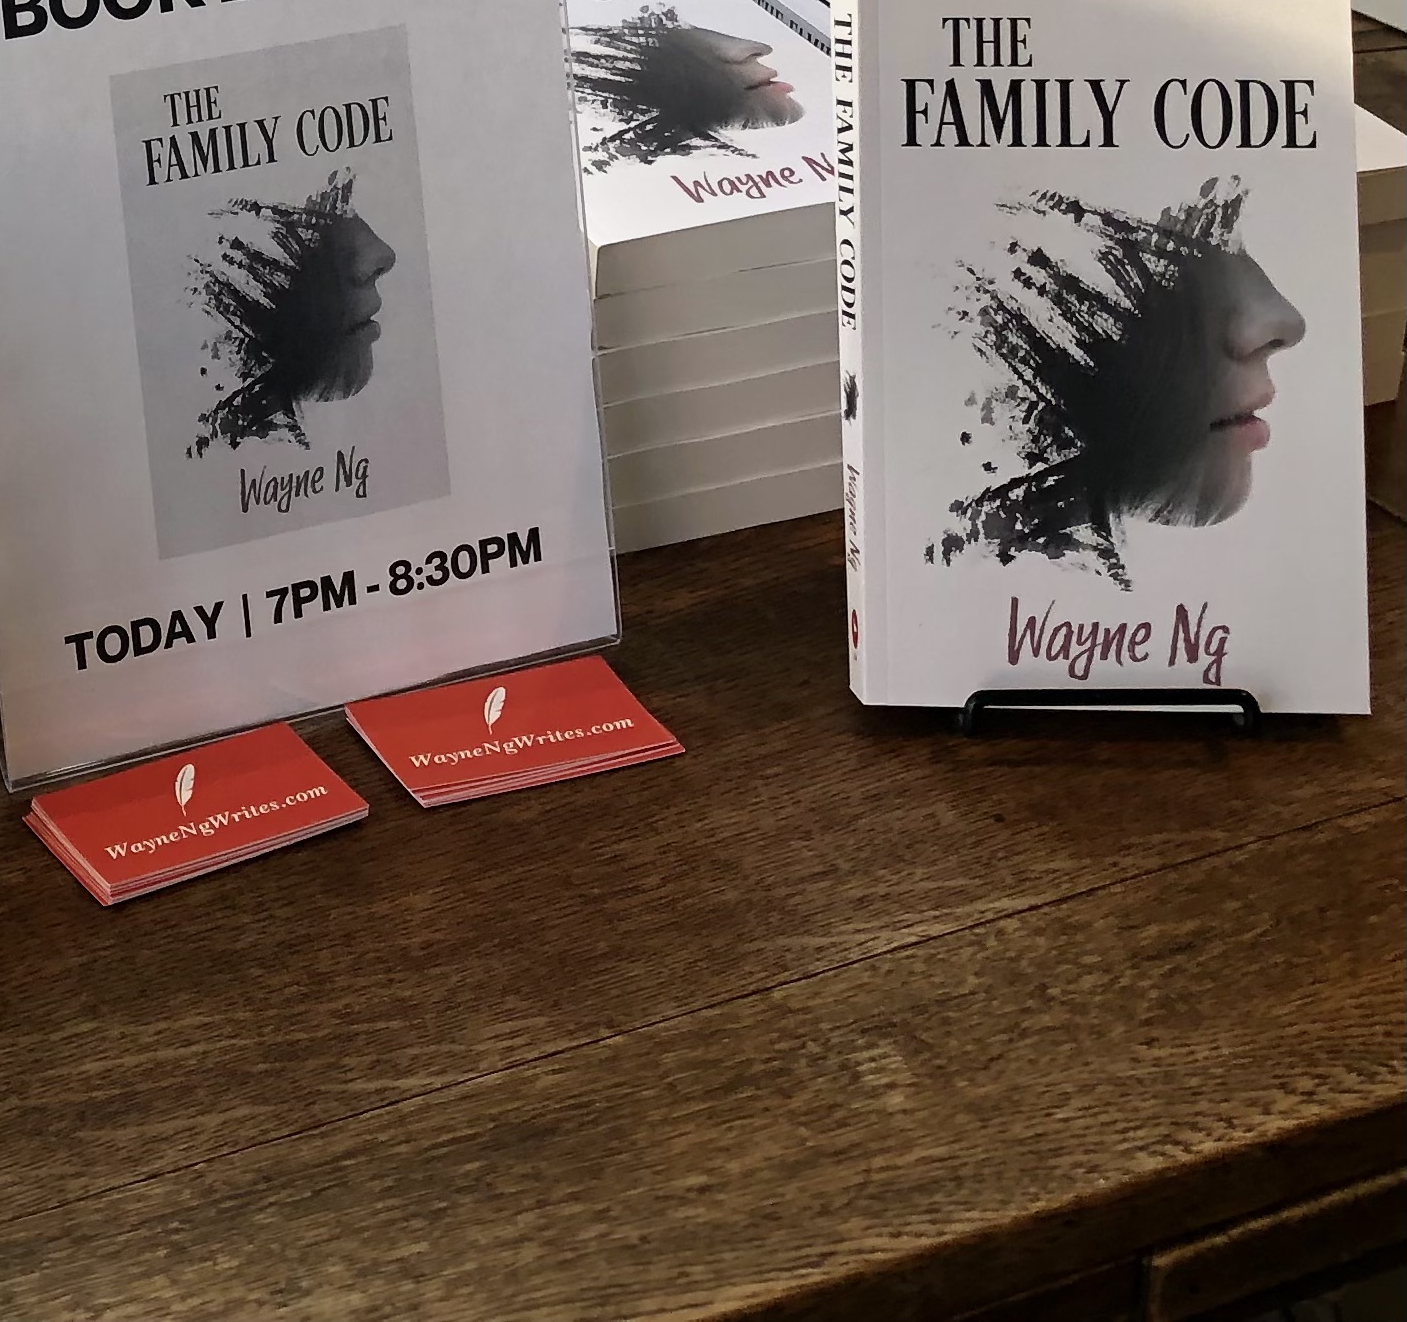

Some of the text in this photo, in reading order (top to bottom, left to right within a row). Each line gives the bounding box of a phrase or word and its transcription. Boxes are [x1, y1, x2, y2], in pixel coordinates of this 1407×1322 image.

[941, 17, 1033, 68] THE
[141, 96, 394, 187] FAMILY CODE
[163, 85, 223, 128] THE
[901, 78, 1317, 149] FAMILY CODE
[670, 152, 835, 205] Wayne N
[833, 13, 857, 331] THE FAMILY CODE
[239, 445, 371, 514] Wayne Ng
[63, 600, 228, 672] TODAY
[264, 570, 358, 626] 7PM
[387, 525, 544, 597] 8:30PM
[1007, 596, 1231, 686] Wayne Ng
[408, 714, 635, 770] WayneNgWrites.com
[104, 781, 329, 862] WayneNgWrites.com
